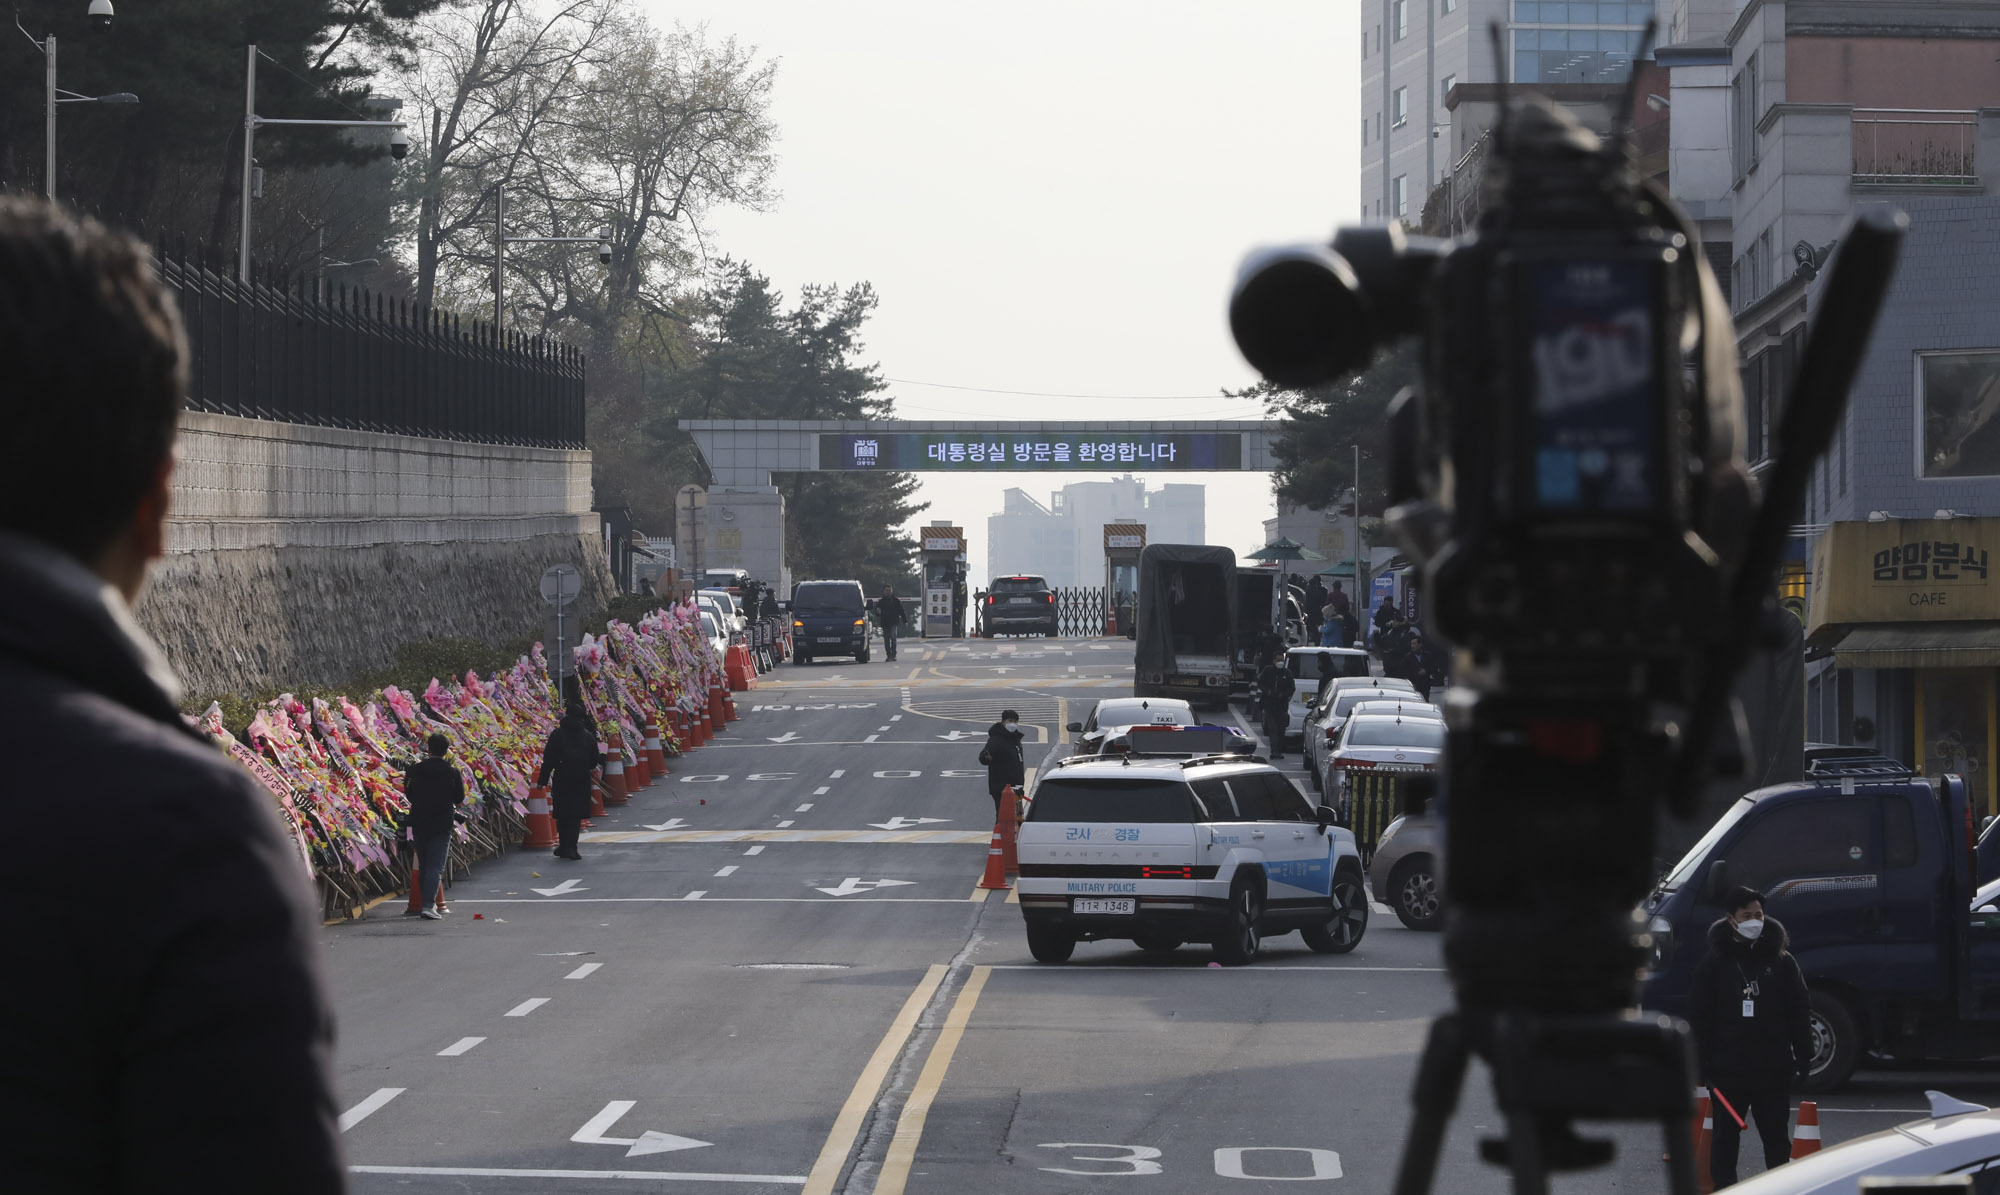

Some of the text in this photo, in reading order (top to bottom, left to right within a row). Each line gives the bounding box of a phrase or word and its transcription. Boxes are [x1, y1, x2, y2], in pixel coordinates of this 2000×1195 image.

[928, 443, 1176, 462] 대통령실 방문을 환영합니다
[1909, 592, 1946, 606] CAFE
[1408, 608, 1415, 617] to
[1066, 827, 1140, 841] 군사 경찰
[1834, 875, 1866, 883] BONGO
[1068, 883, 1136, 892] MILITARY POLICE
[1104, 902, 1129, 911] 1348
[1037, 1143, 1343, 1181] 30
